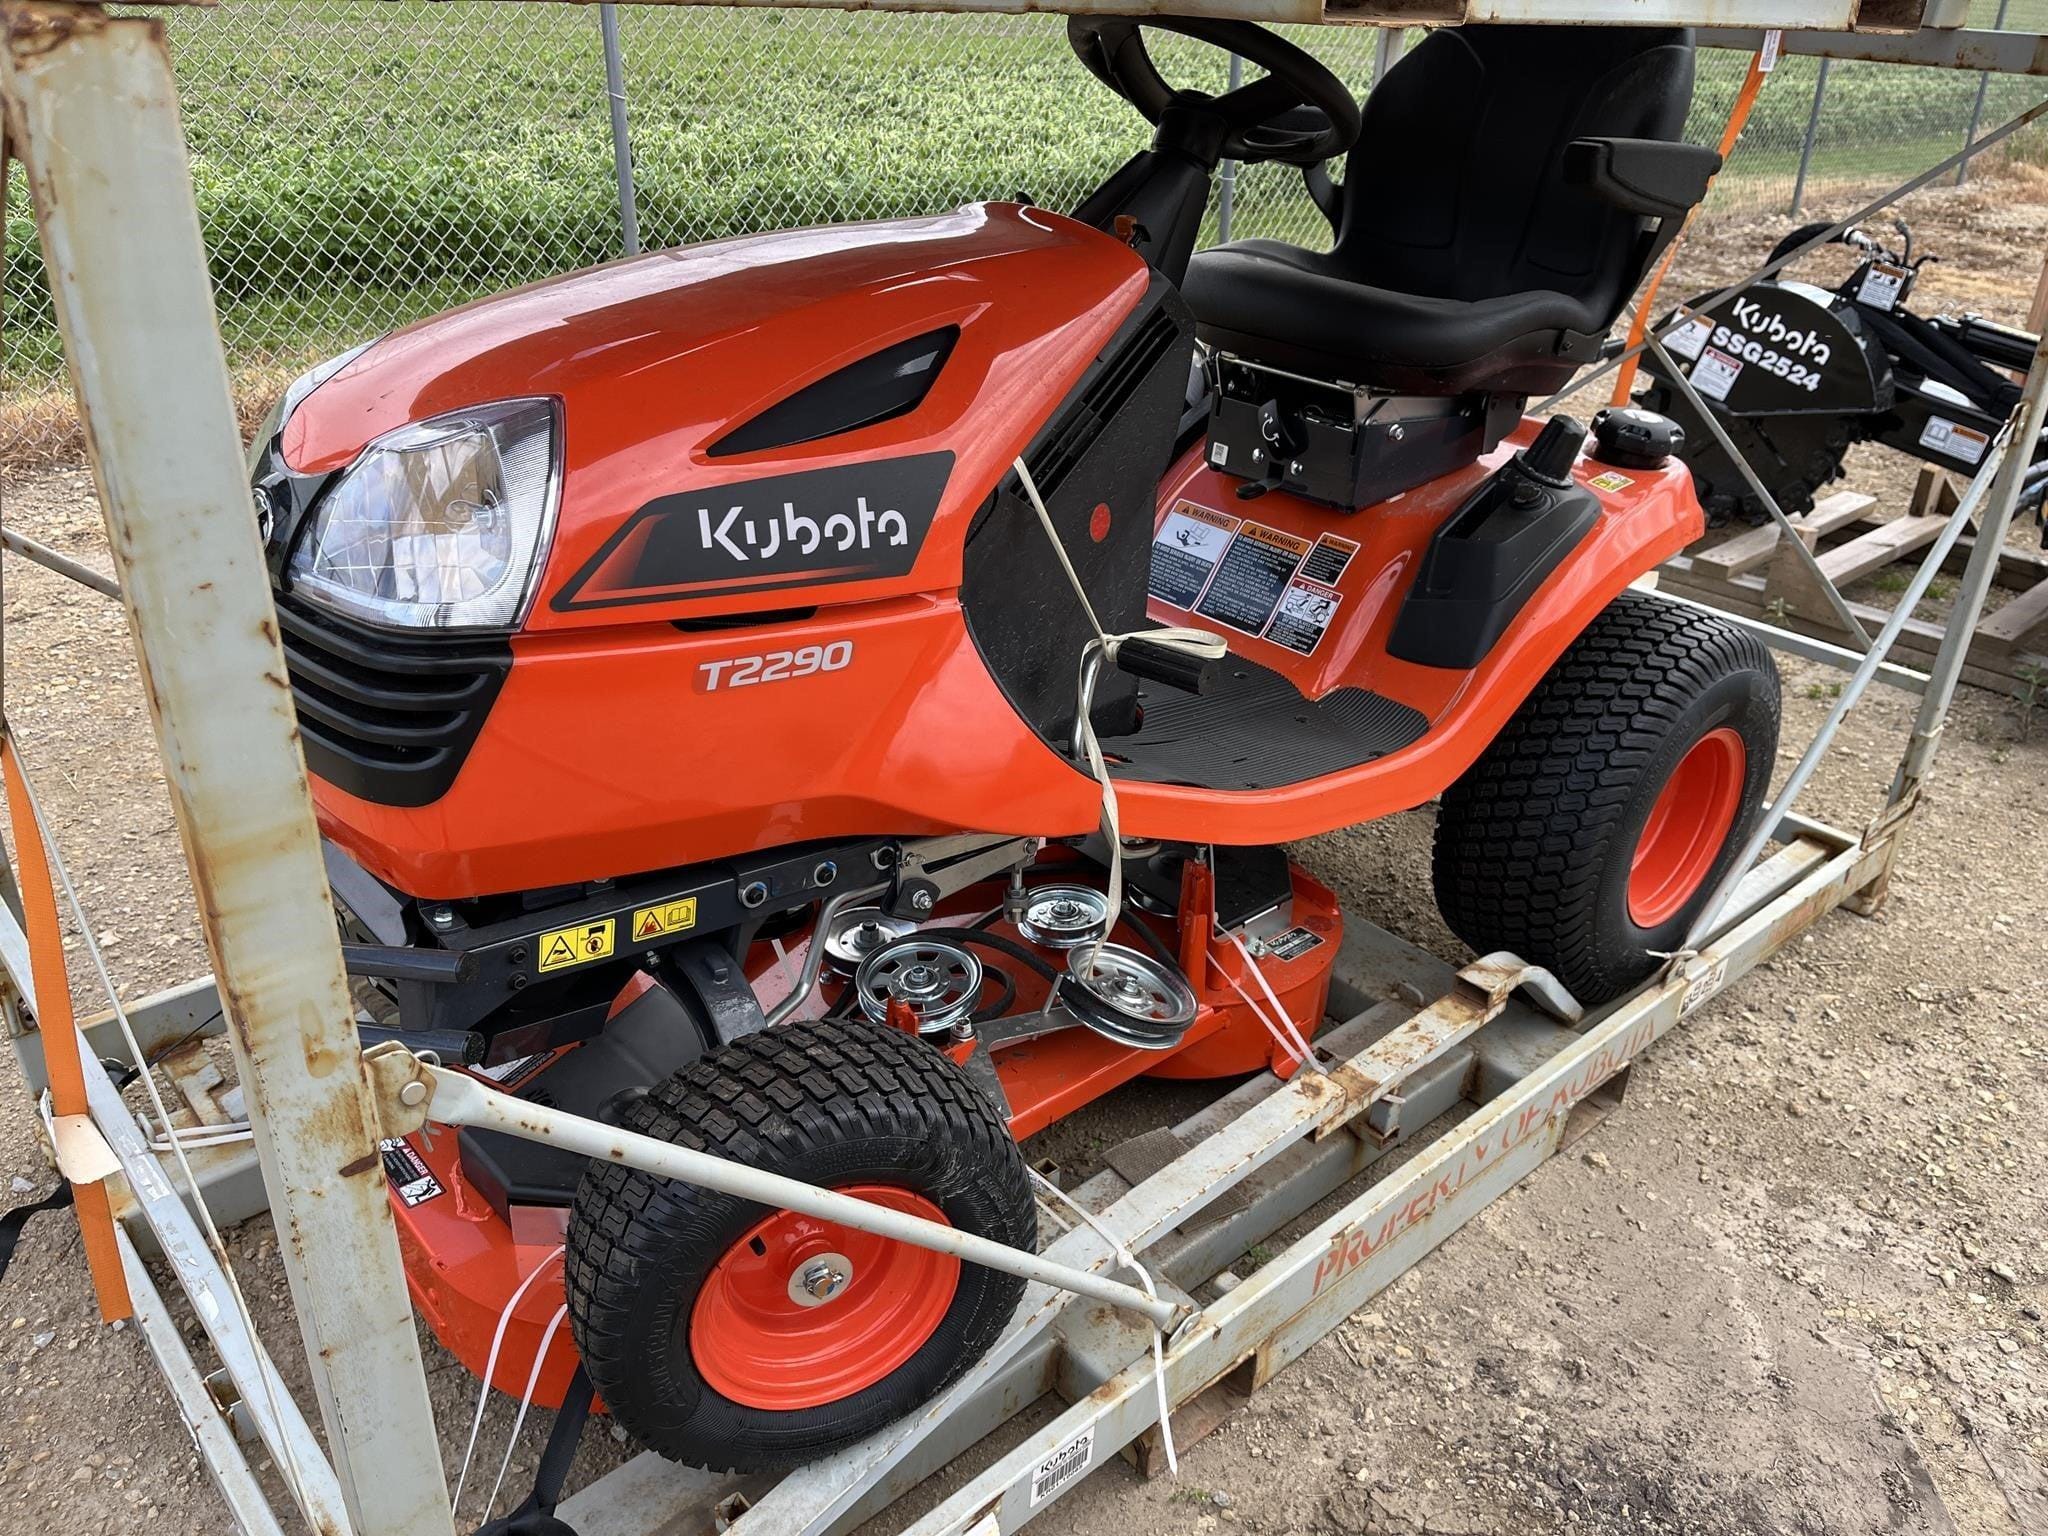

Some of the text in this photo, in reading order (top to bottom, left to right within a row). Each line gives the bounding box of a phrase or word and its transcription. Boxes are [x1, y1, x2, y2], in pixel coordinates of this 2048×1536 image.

[1731, 296, 1832, 366] Kubota
[1711, 325, 1823, 392] SSG2524
[698, 497, 909, 561] Kubota
[1189, 506, 1231, 528] WARNING
[1257, 528, 1300, 552] WARNING
[1306, 585, 1334, 600] DANGER
[698, 640, 853, 692] T2290
[408, 1151, 428, 1176] DANGER
[1041, 1436, 1088, 1474] Kubota
